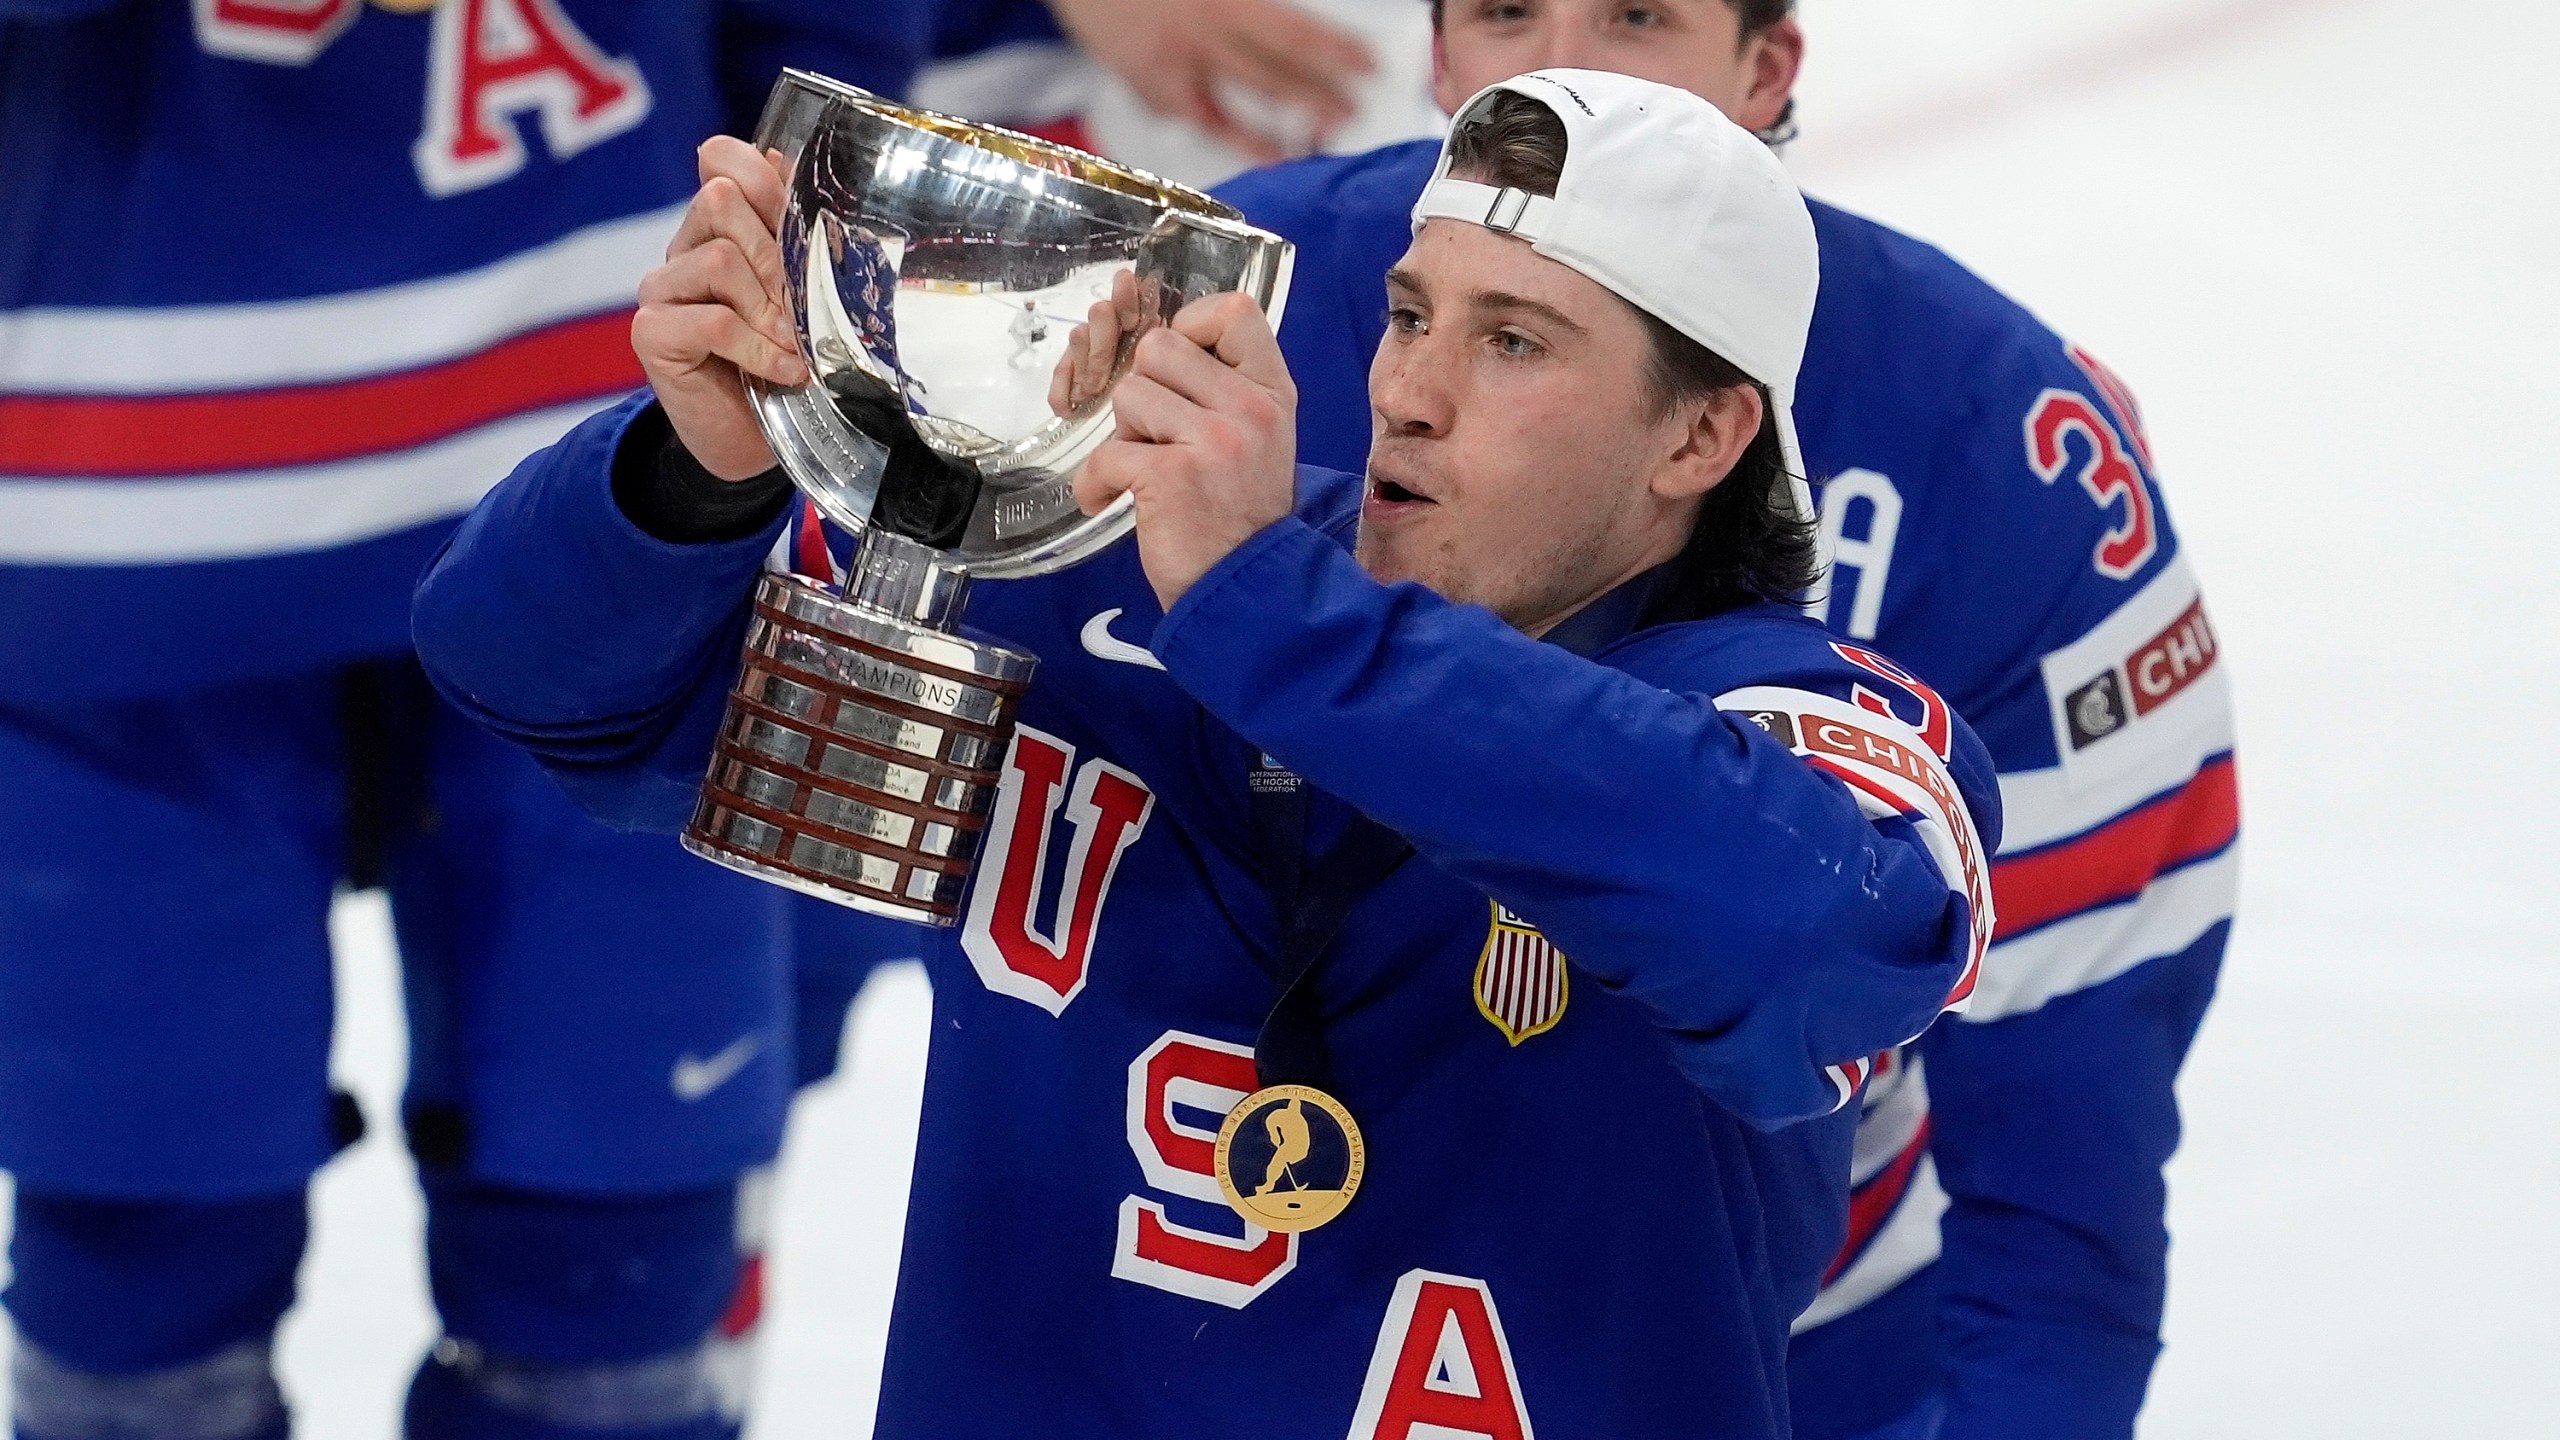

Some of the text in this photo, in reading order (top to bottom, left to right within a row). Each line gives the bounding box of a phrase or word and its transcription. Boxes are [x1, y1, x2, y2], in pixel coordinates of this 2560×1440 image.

[1803, 466, 1904, 641] A
[1249, 777, 1303, 786] ICE HOCKEY
